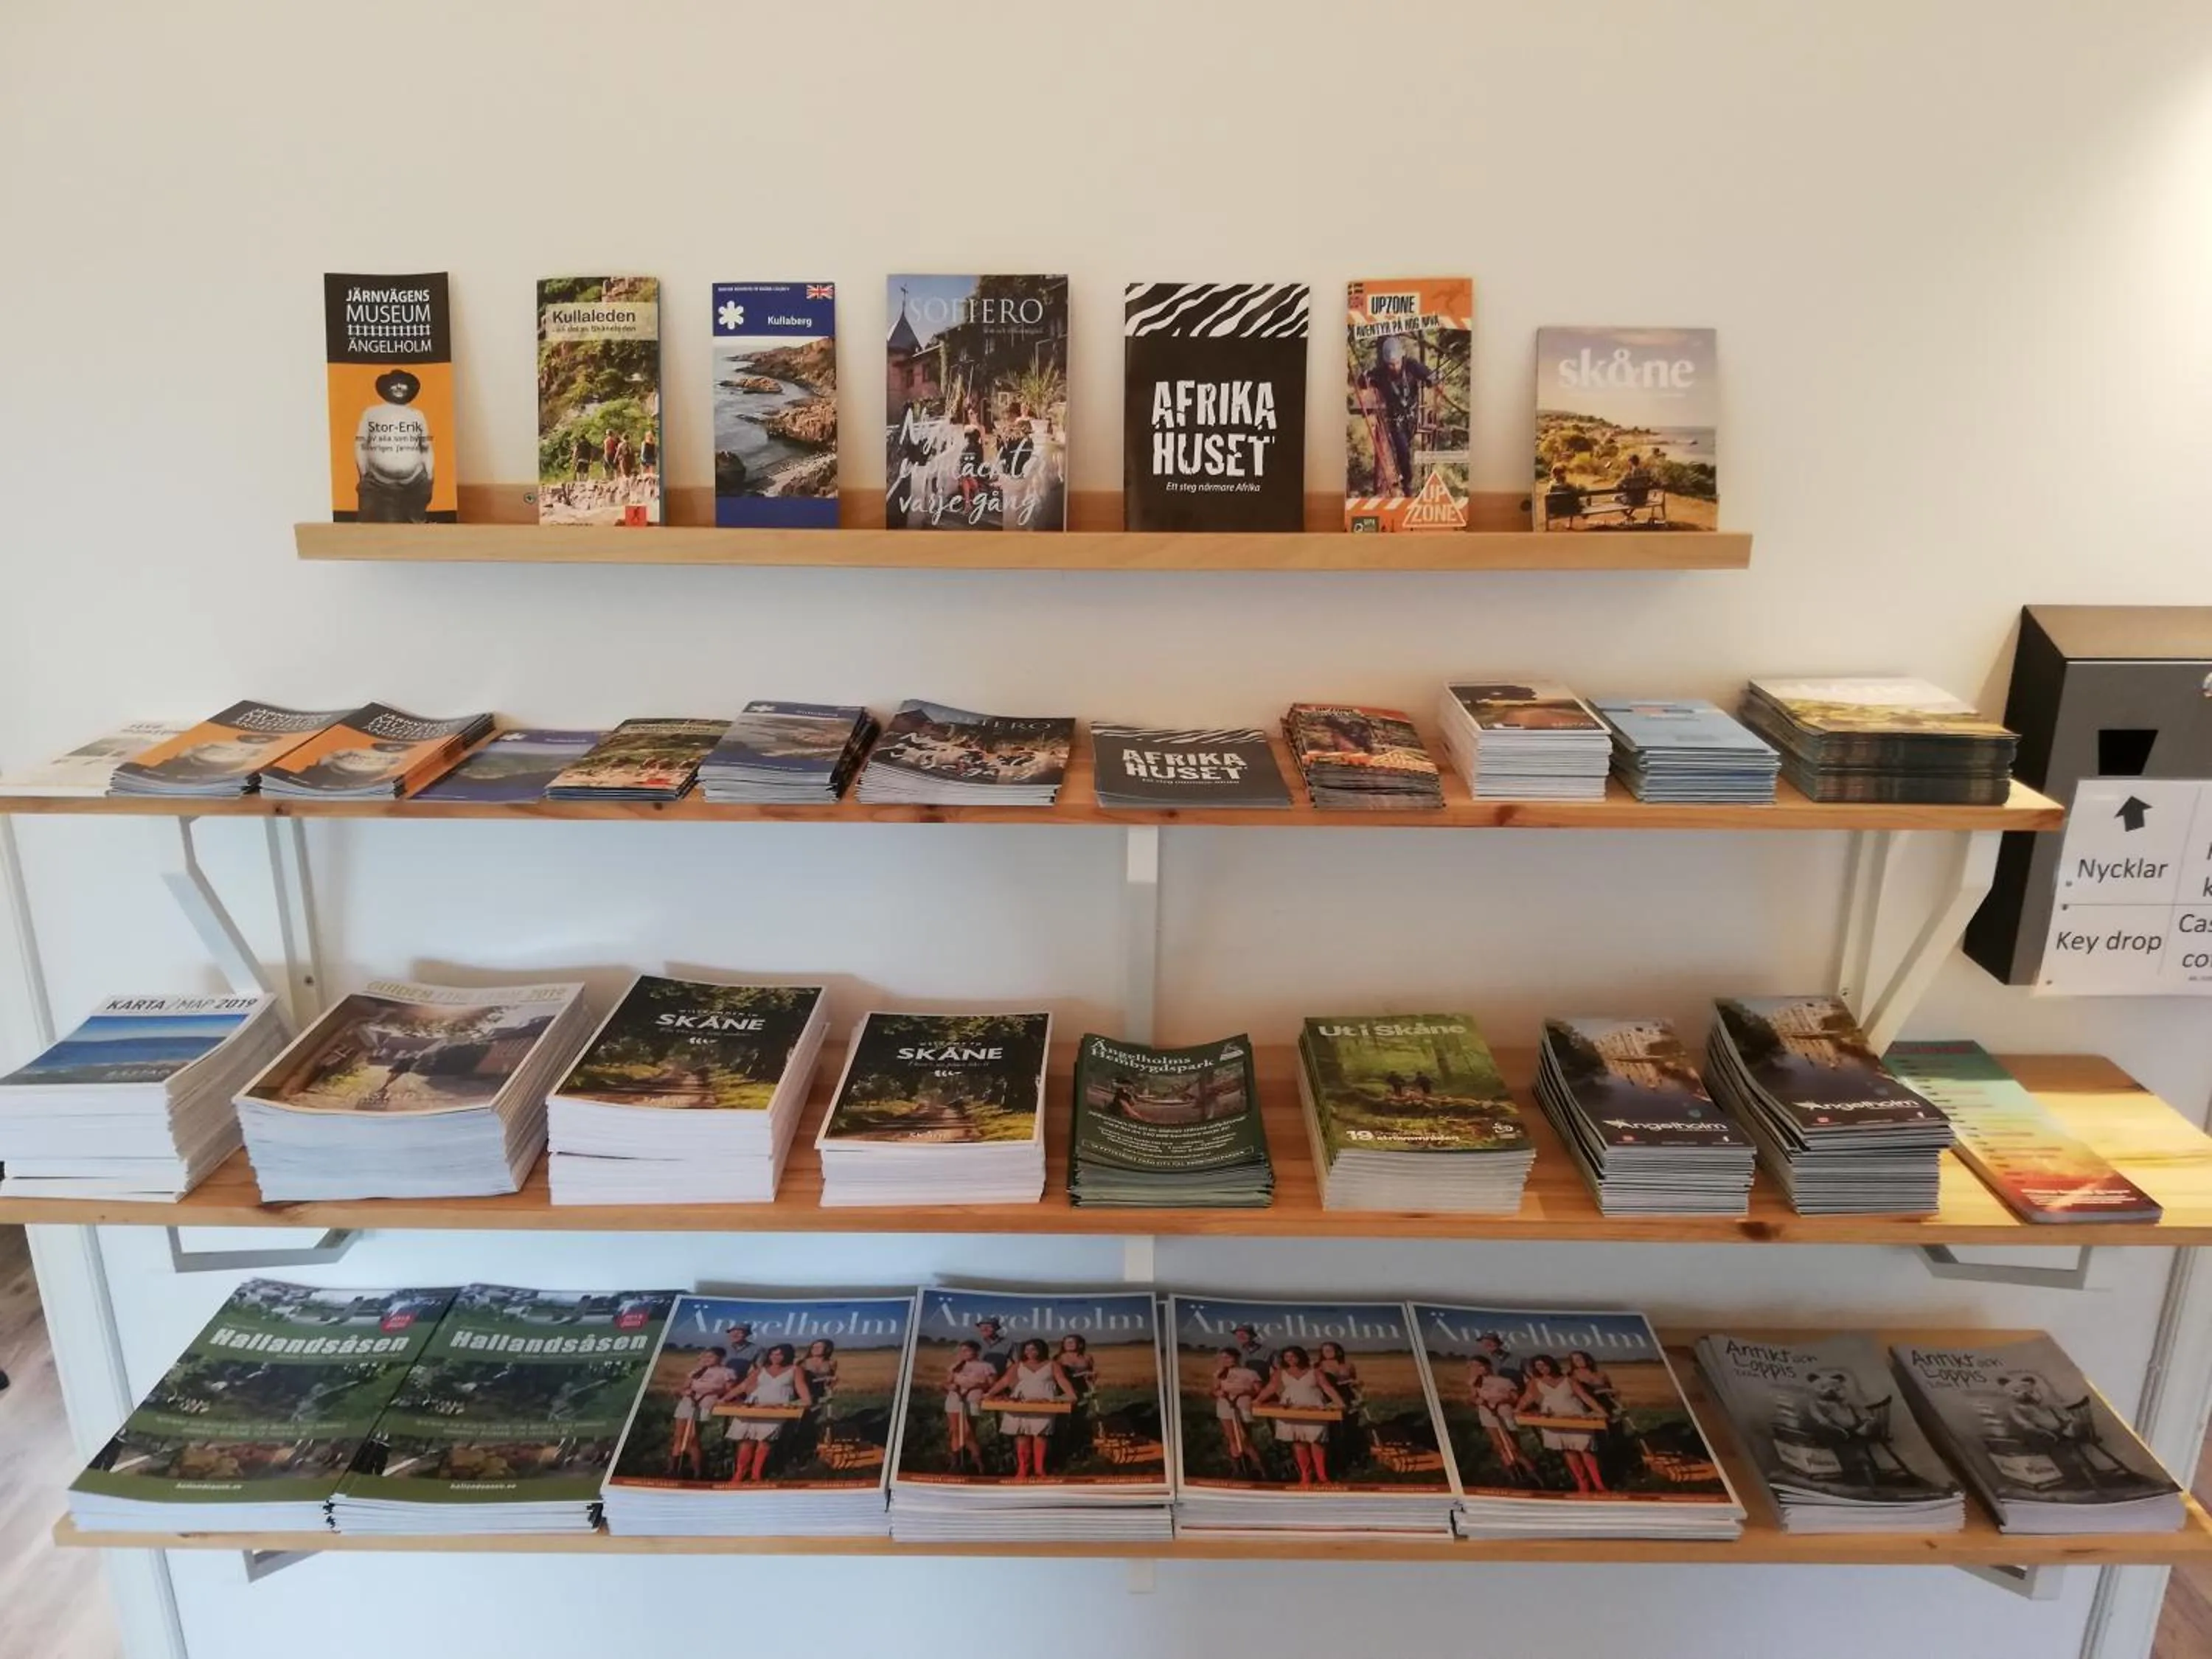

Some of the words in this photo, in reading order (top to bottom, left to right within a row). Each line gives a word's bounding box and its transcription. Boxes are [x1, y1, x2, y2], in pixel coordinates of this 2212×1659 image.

[346, 287, 430, 303] JÄRNVÄGENS
[346, 304, 431, 323] MUSEUM
[1371, 296, 1416, 314] UPZONE
[552, 309, 636, 324] Kullaleden
[768, 316, 812, 327] Kullaberg
[347, 337, 432, 353] ÄNGELHOLM
[1152, 380, 1277, 430] AFRIKA
[368, 421, 422, 433] Stor-Erik
[1152, 432, 1275, 476] HUSET
[1180, 481, 1197, 493] steg
[1235, 482, 1262, 492] Afrika
[1423, 484, 1447, 502] UP
[1412, 504, 1457, 522] ZONE
[1122, 749, 1248, 765] AFRIKA
[1126, 762, 1248, 779] HUSET
[2078, 858, 2168, 883] Nycklar
[2056, 931, 2099, 954] Key
[2107, 931, 2162, 954] drop
[106, 999, 165, 1010] KARTA
[655, 1014, 766, 1030] SKÅNE
[897, 1046, 1004, 1061] SKÅNE
[1091, 1037, 1191, 1065] Ängelholms
[209, 1329, 410, 1354] Hallandsåsen
[450, 1331, 648, 1354] Hallandsåsen
